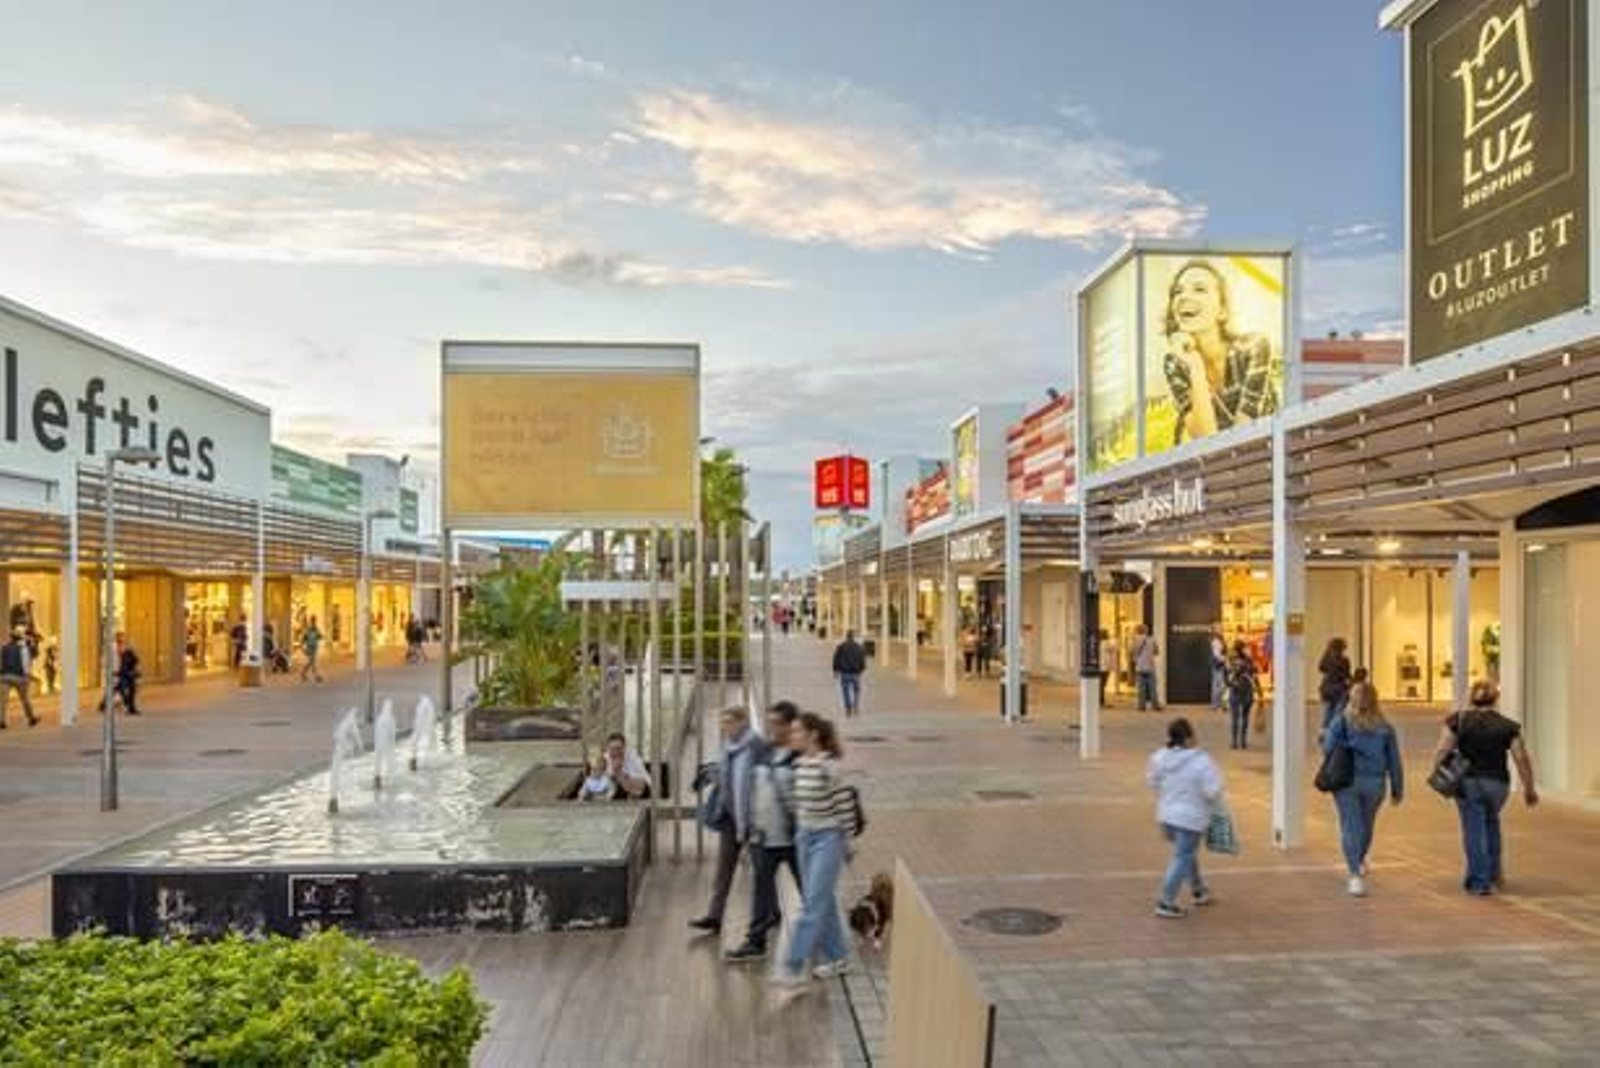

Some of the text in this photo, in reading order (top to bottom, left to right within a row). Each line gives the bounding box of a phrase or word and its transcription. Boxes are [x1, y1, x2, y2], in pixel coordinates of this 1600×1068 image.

[1463, 113, 1533, 186] LUZ
[1463, 160, 1533, 209] SHOPPING
[1429, 213, 1573, 300] OUTLET
[5, 347, 215, 483] lefties
